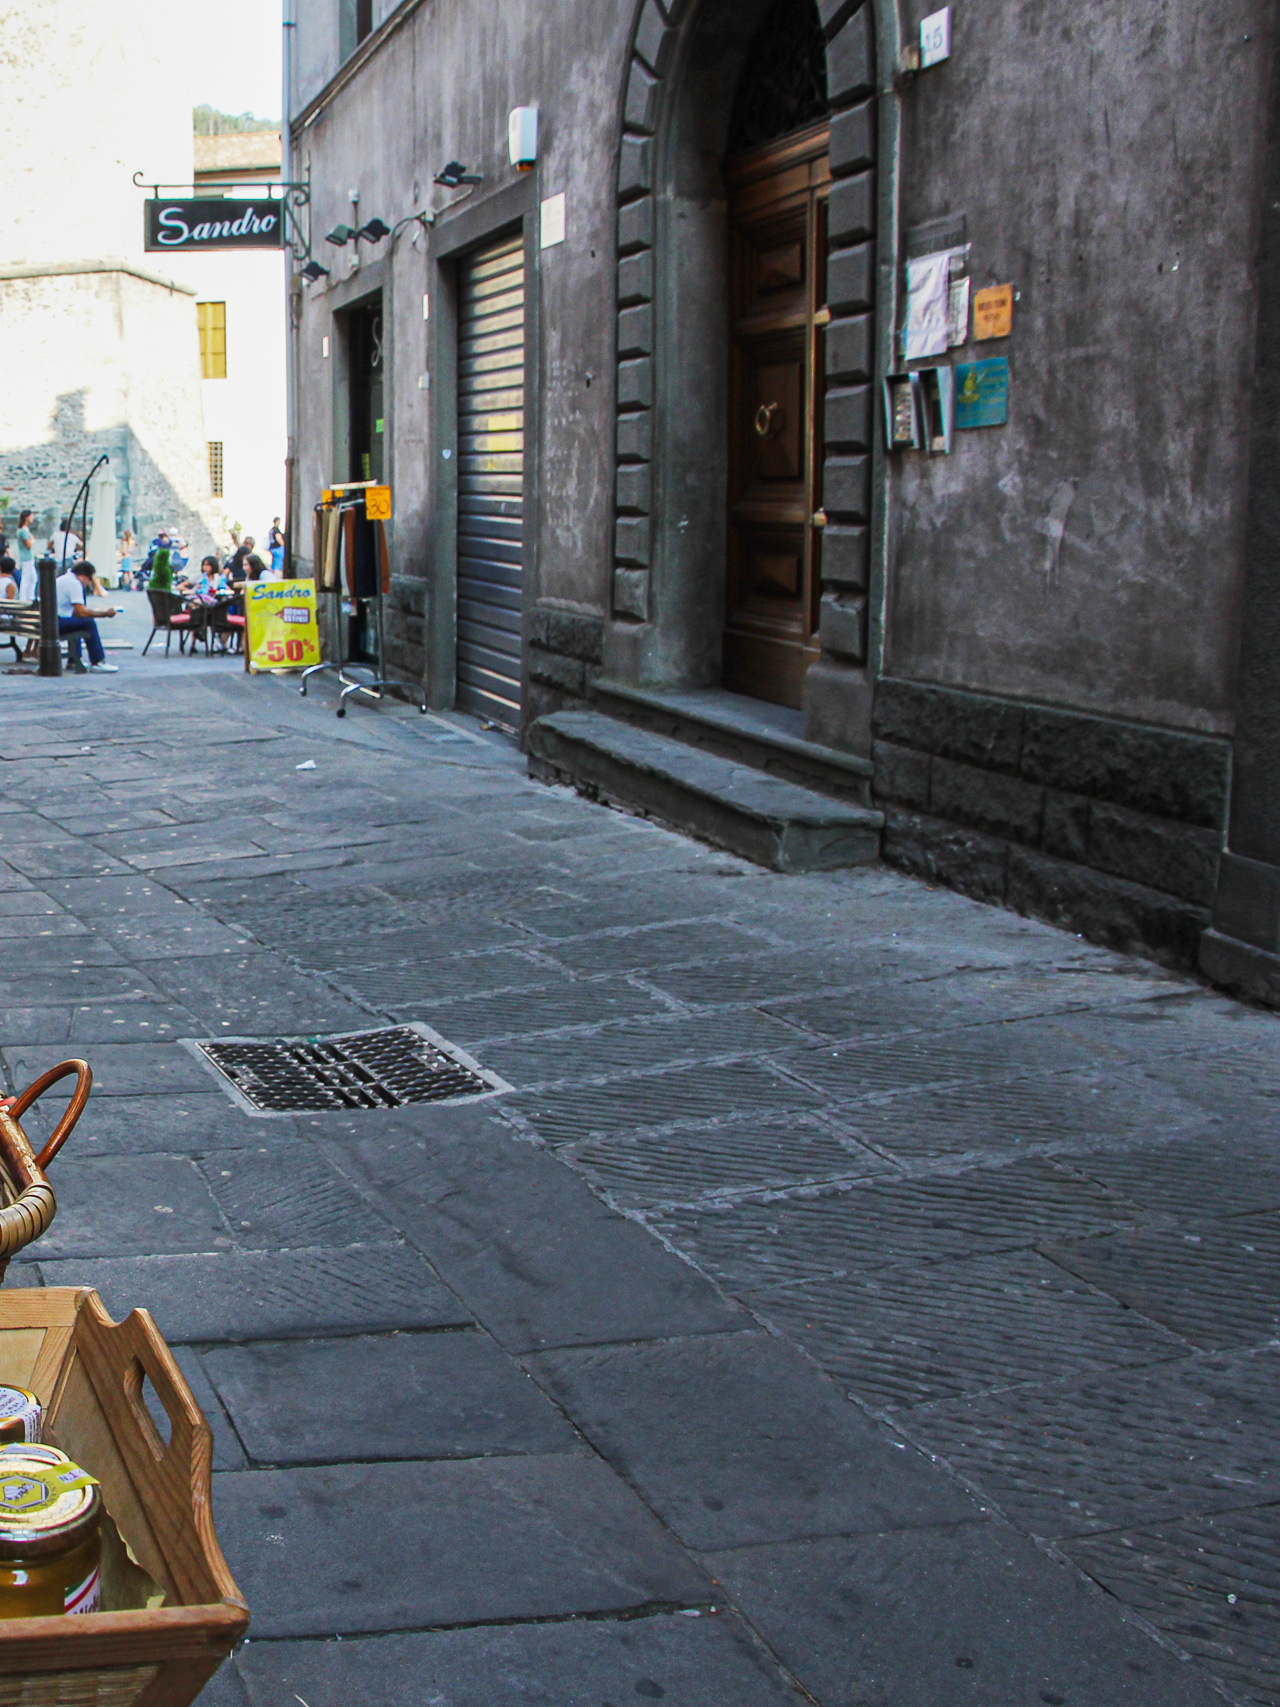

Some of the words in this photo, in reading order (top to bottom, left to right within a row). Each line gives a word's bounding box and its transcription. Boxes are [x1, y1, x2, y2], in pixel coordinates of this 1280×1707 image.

[924, 26, 943, 52] 15
[157, 207, 278, 245] Sandro
[252, 584, 312, 600] Sandro
[257, 638, 315, 662] -50%
